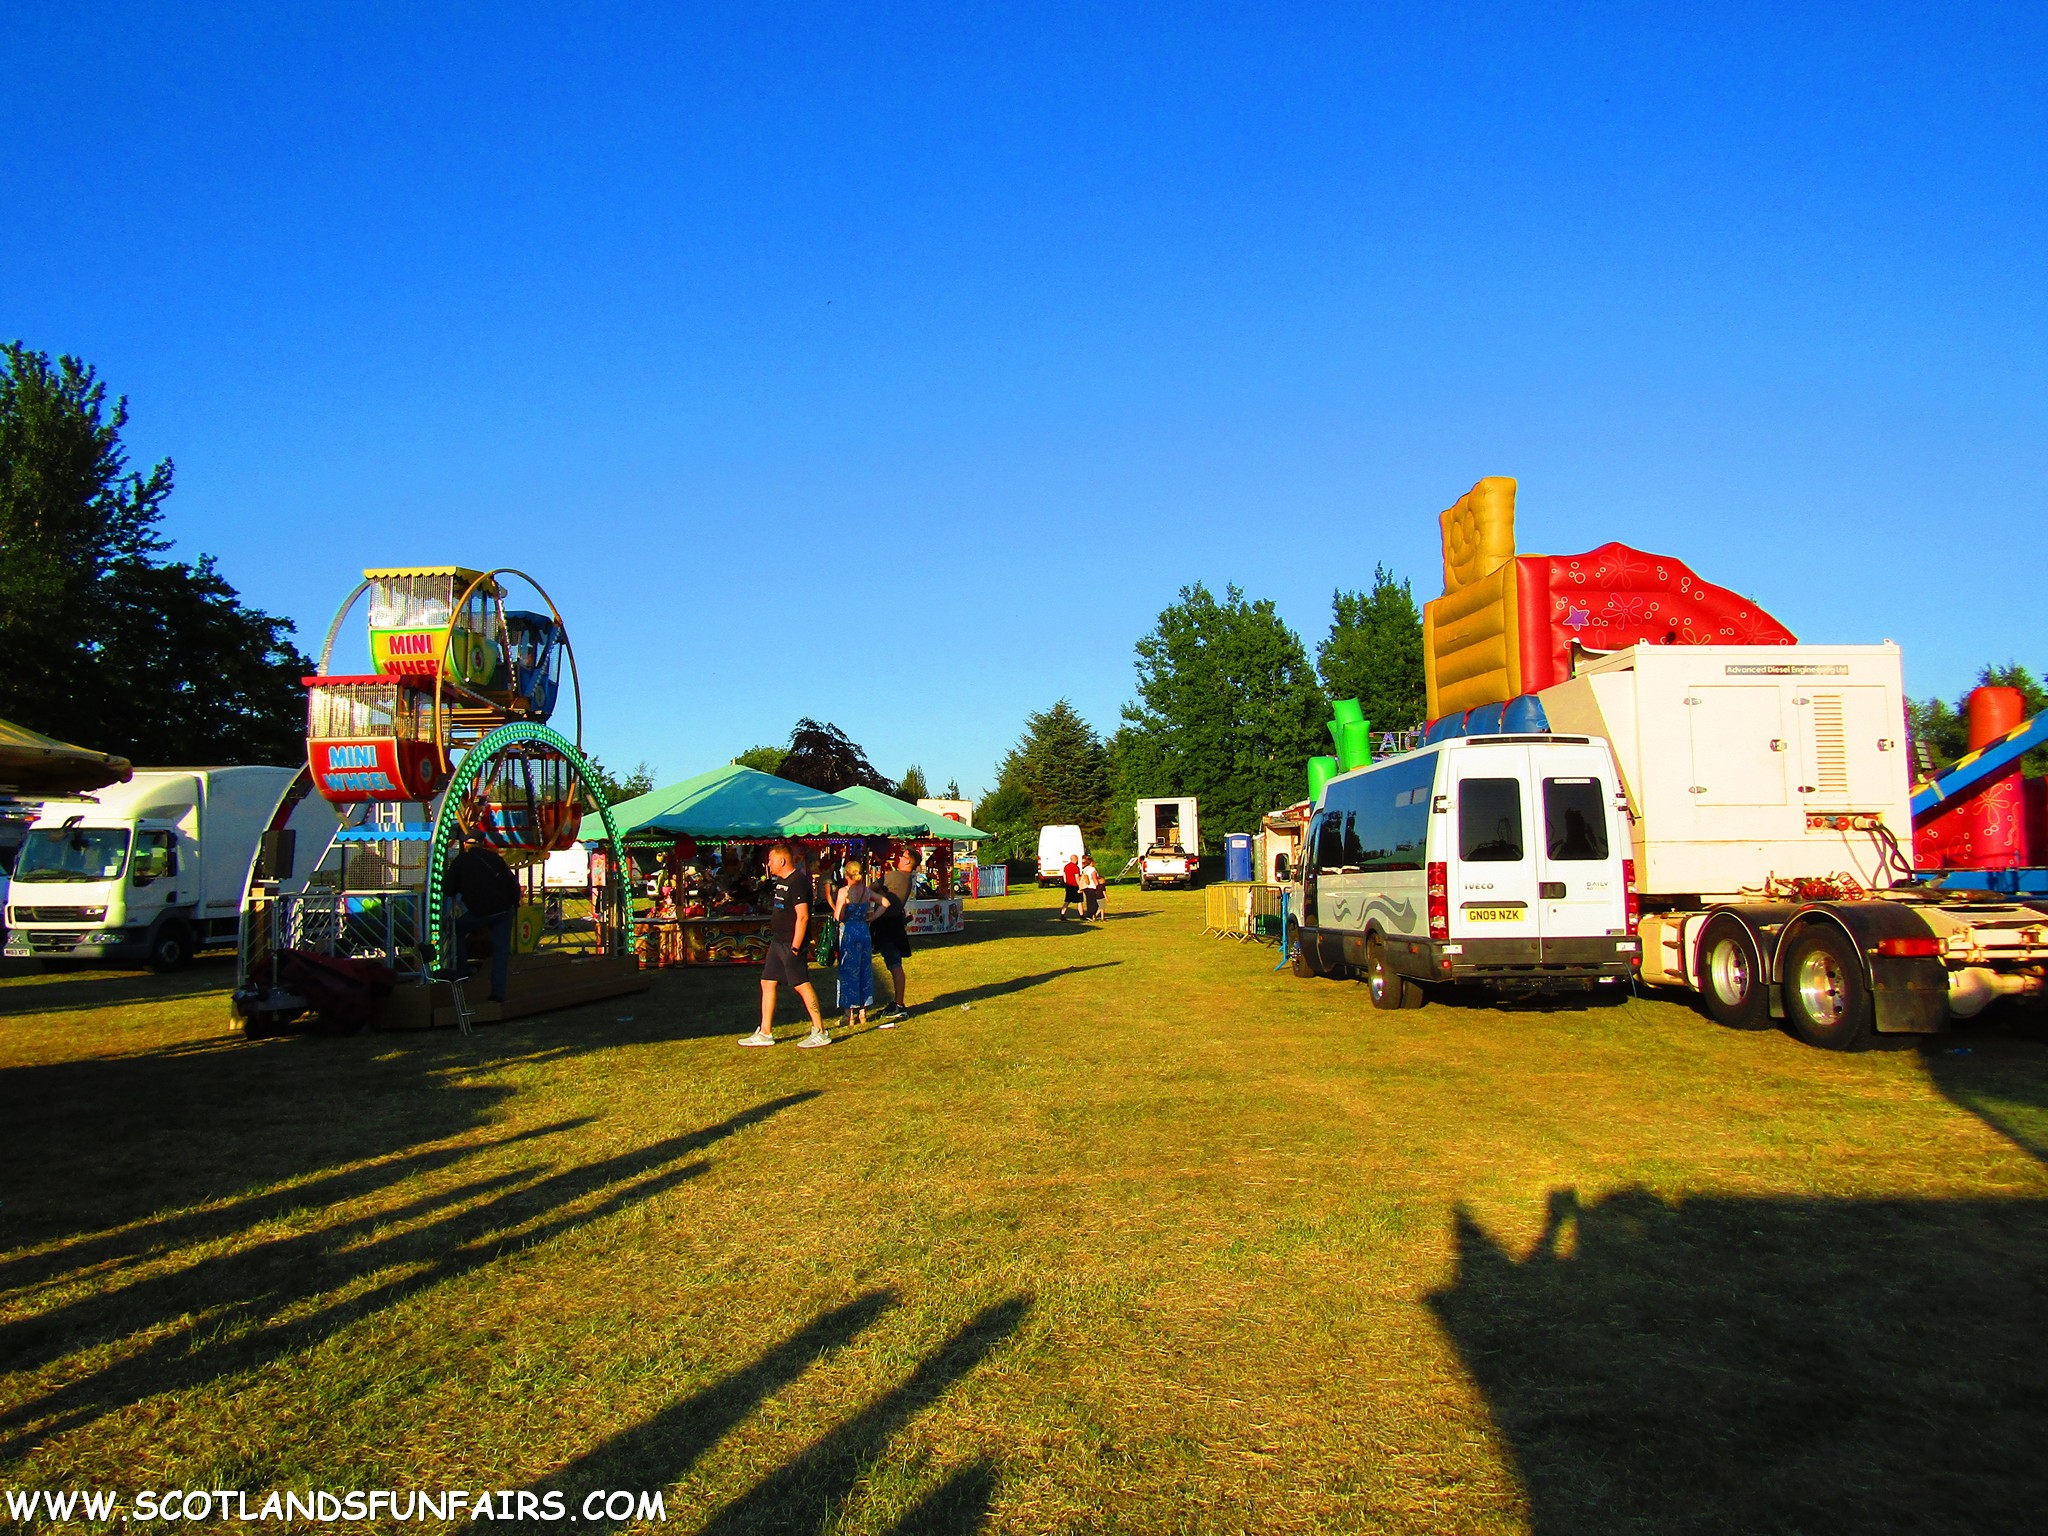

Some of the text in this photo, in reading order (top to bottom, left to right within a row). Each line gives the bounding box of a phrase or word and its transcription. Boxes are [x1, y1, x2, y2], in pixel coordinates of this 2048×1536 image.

[389, 634, 433, 655] MINI
[1726, 666, 1767, 674] Advanced
[1767, 666, 1791, 674] Diesel
[328, 745, 378, 768] MINI
[322, 772, 397, 792] WHEEL
[1464, 882, 1495, 891] IVECO
[1469, 909, 1520, 921] GN09 NZK
